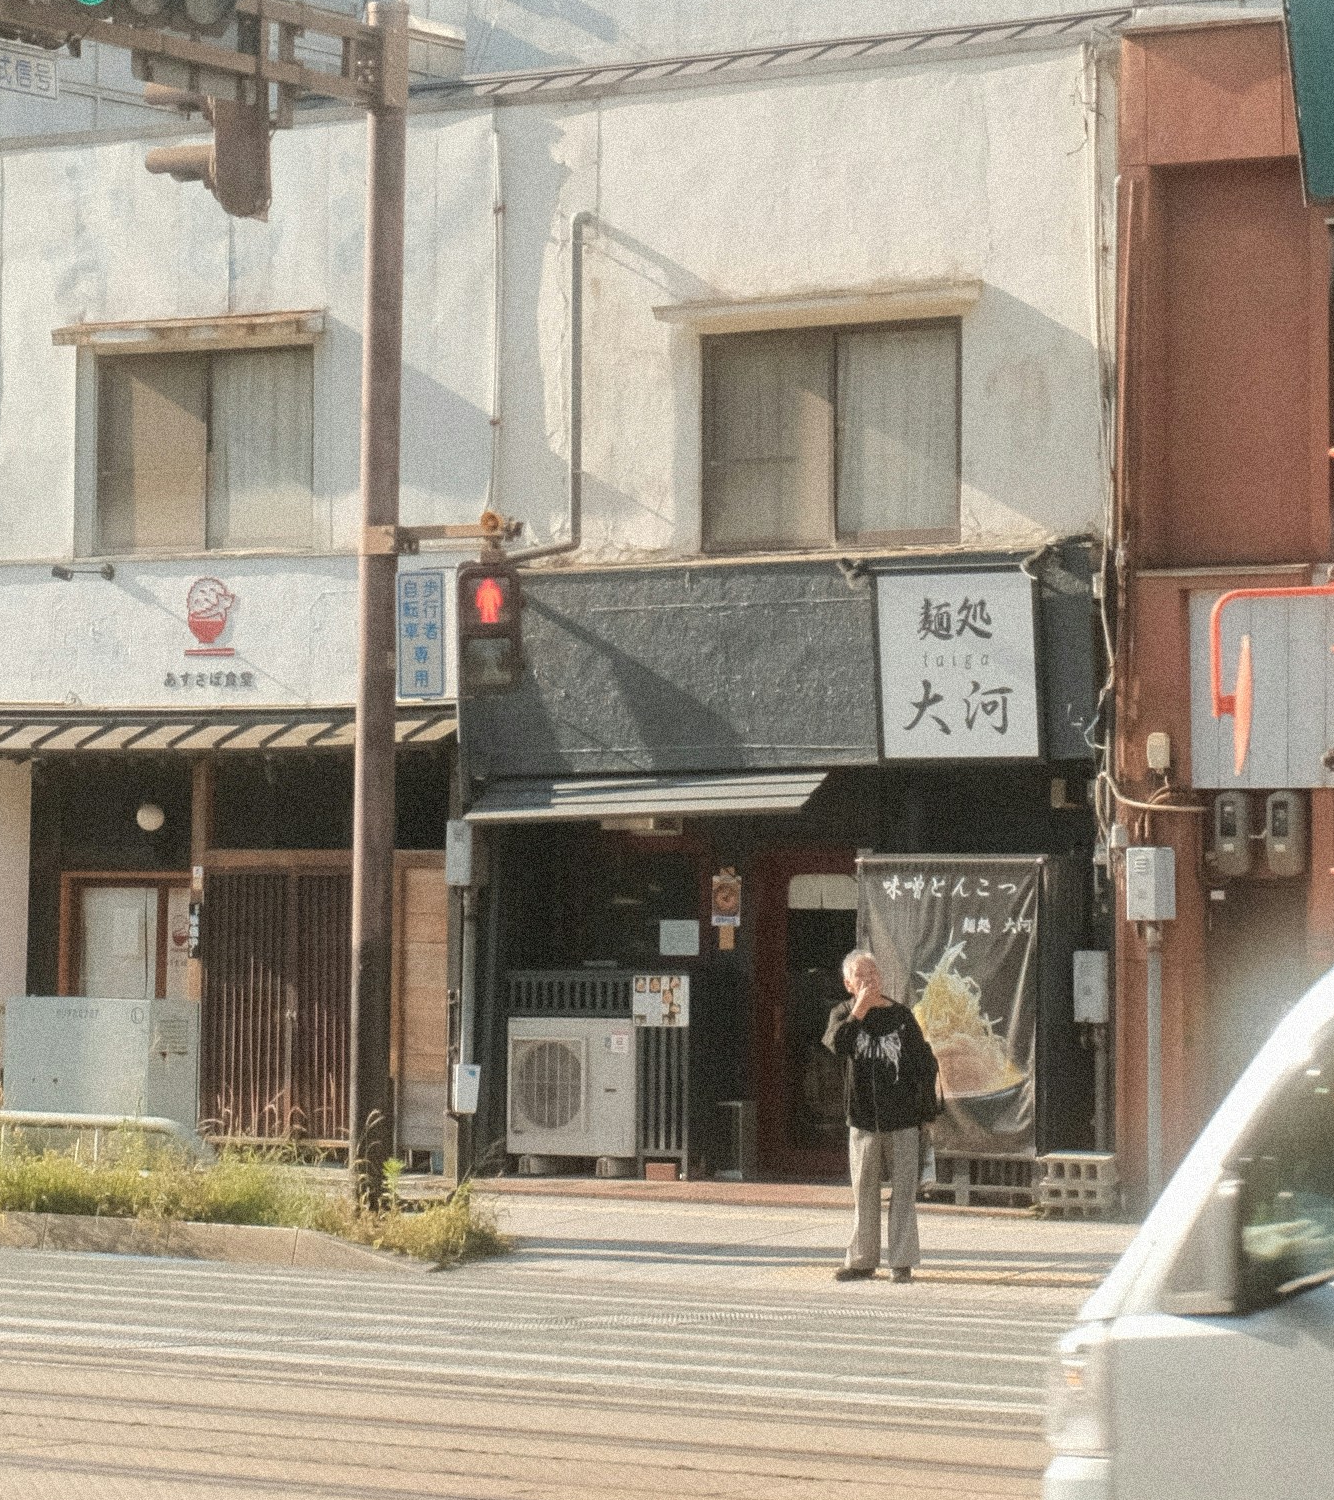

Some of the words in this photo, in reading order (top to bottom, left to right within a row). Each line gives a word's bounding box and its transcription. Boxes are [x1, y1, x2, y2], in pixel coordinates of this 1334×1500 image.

[403, 580, 419, 640] 自転車
[423, 580, 439, 640] 歩行者
[917, 596, 993, 641] 麺処
[413, 645, 428, 688] 専用
[922, 650, 990, 670] taiga
[902, 678, 1015, 736] 大河
